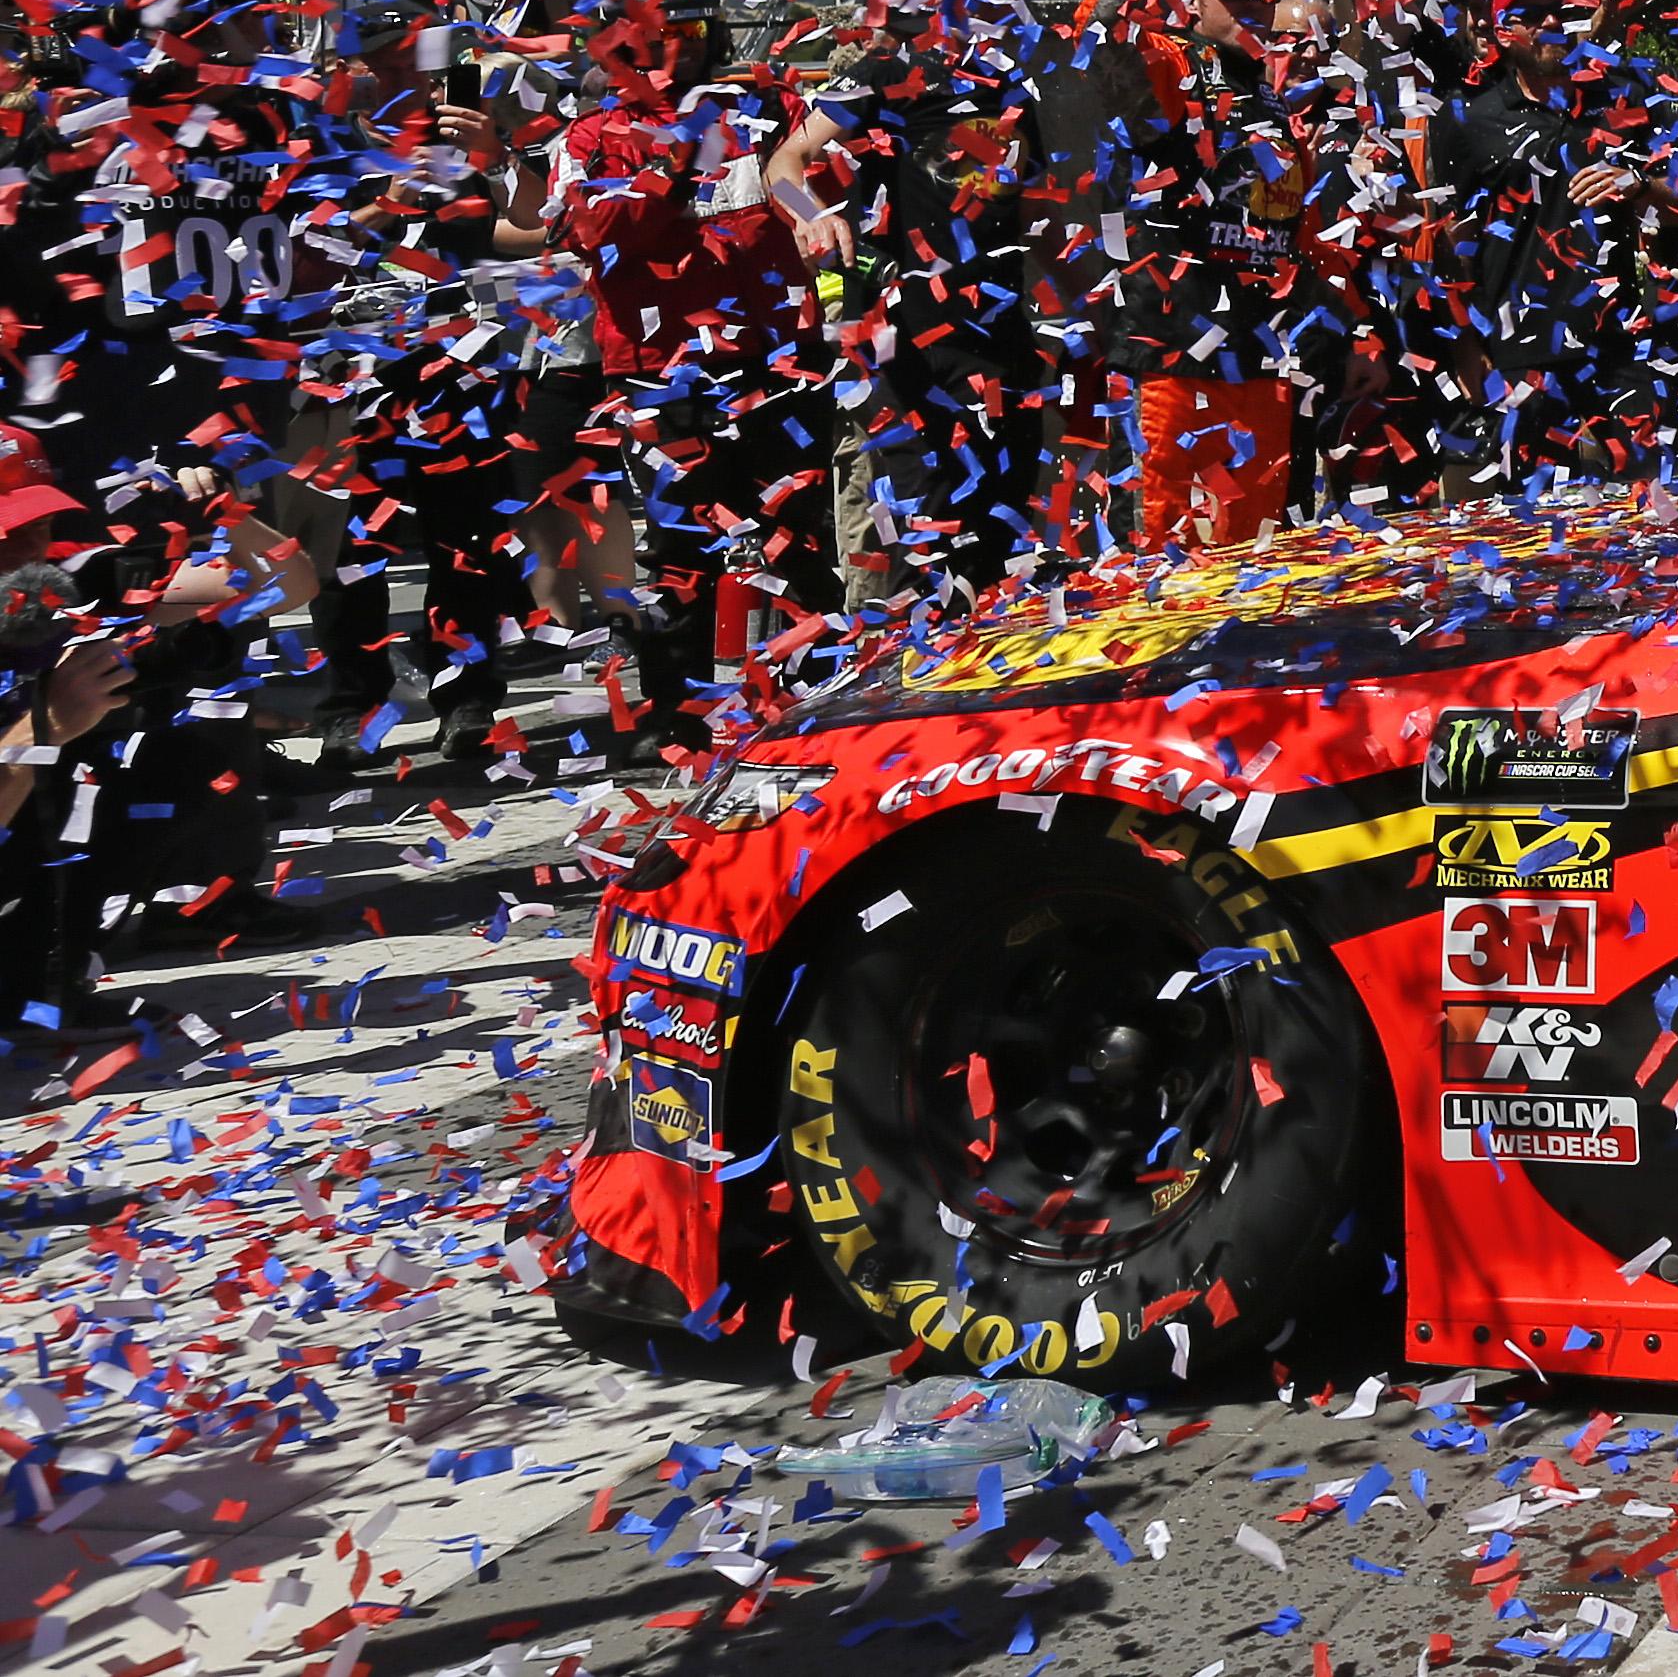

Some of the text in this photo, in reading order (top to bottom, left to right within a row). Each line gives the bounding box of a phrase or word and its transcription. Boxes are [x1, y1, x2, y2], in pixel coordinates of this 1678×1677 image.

[877, 738, 1240, 822] GOODYEAR
[1511, 764, 1552, 777] NASCAR
[1554, 764, 1576, 777] CUP
[1106, 805, 1301, 972] EAGLE
[1436, 865, 1609, 889] MECHANIX WEAR
[611, 914, 743, 988] MOOG
[1447, 902, 1591, 988] 3M
[1453, 1096, 1611, 1131] LINCOLN
[1488, 1131, 1620, 1160] WELDERS
